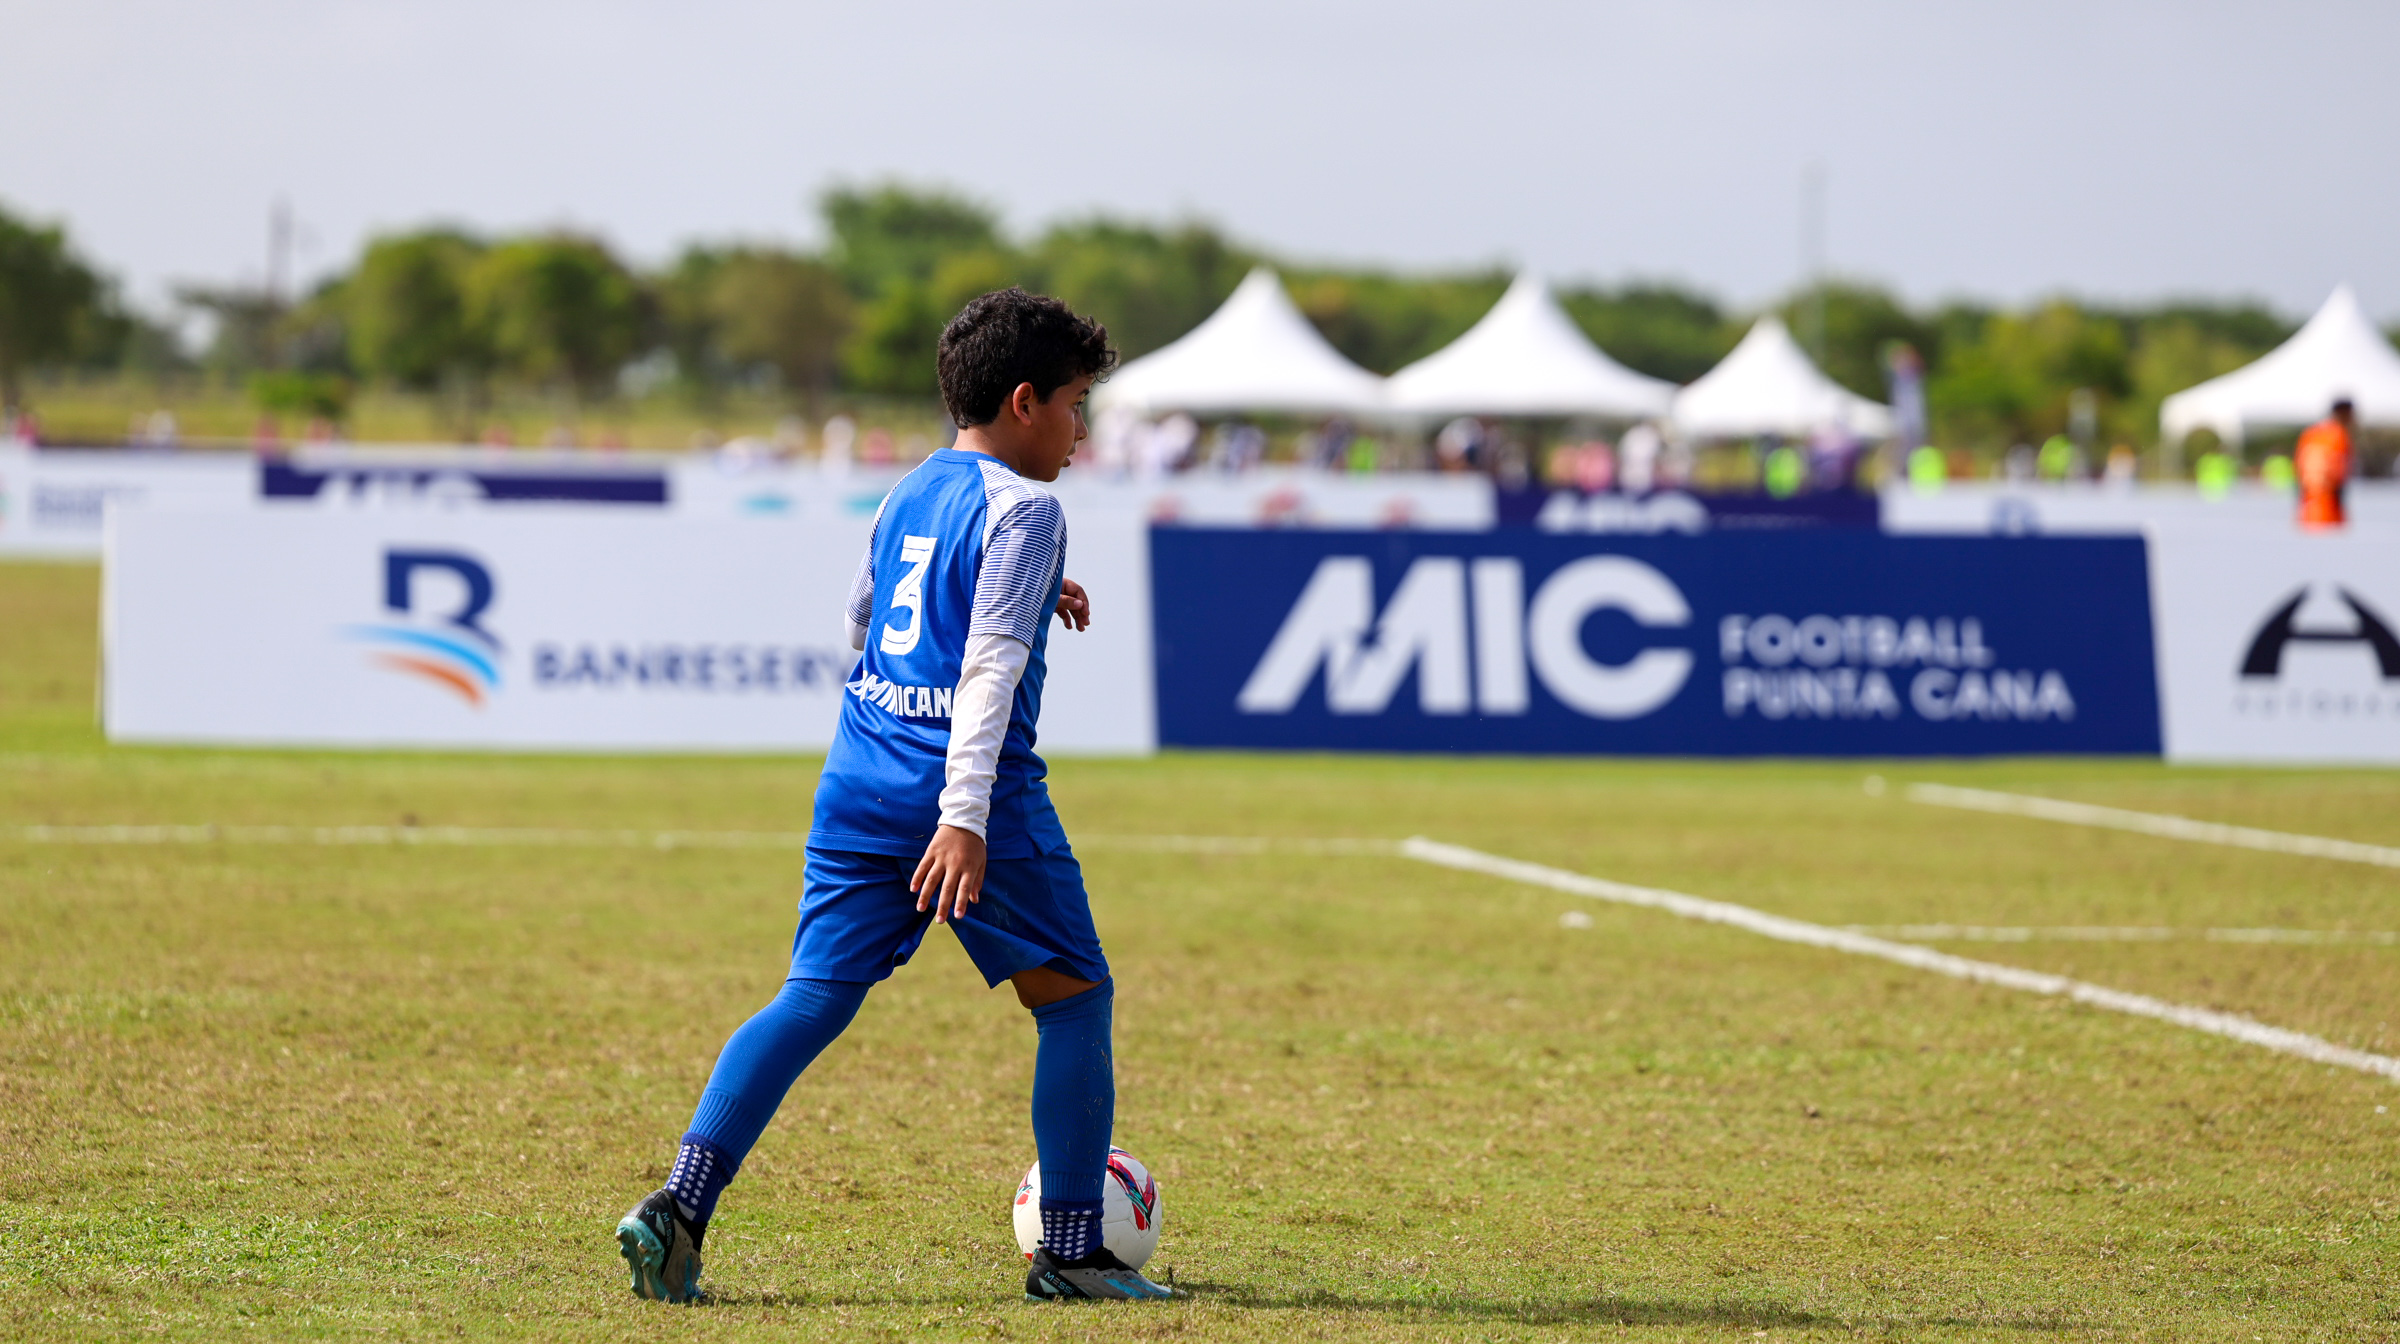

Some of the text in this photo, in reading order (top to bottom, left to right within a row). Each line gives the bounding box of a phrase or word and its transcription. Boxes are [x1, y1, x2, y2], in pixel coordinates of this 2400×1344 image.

[880, 534, 938, 656] 3
[1237, 553, 1694, 720] MIC
[1719, 614, 1994, 667] FOOTBALL
[1722, 667, 2076, 721] PUNTA CANA
[1044, 1271, 1075, 1295] MESSI
